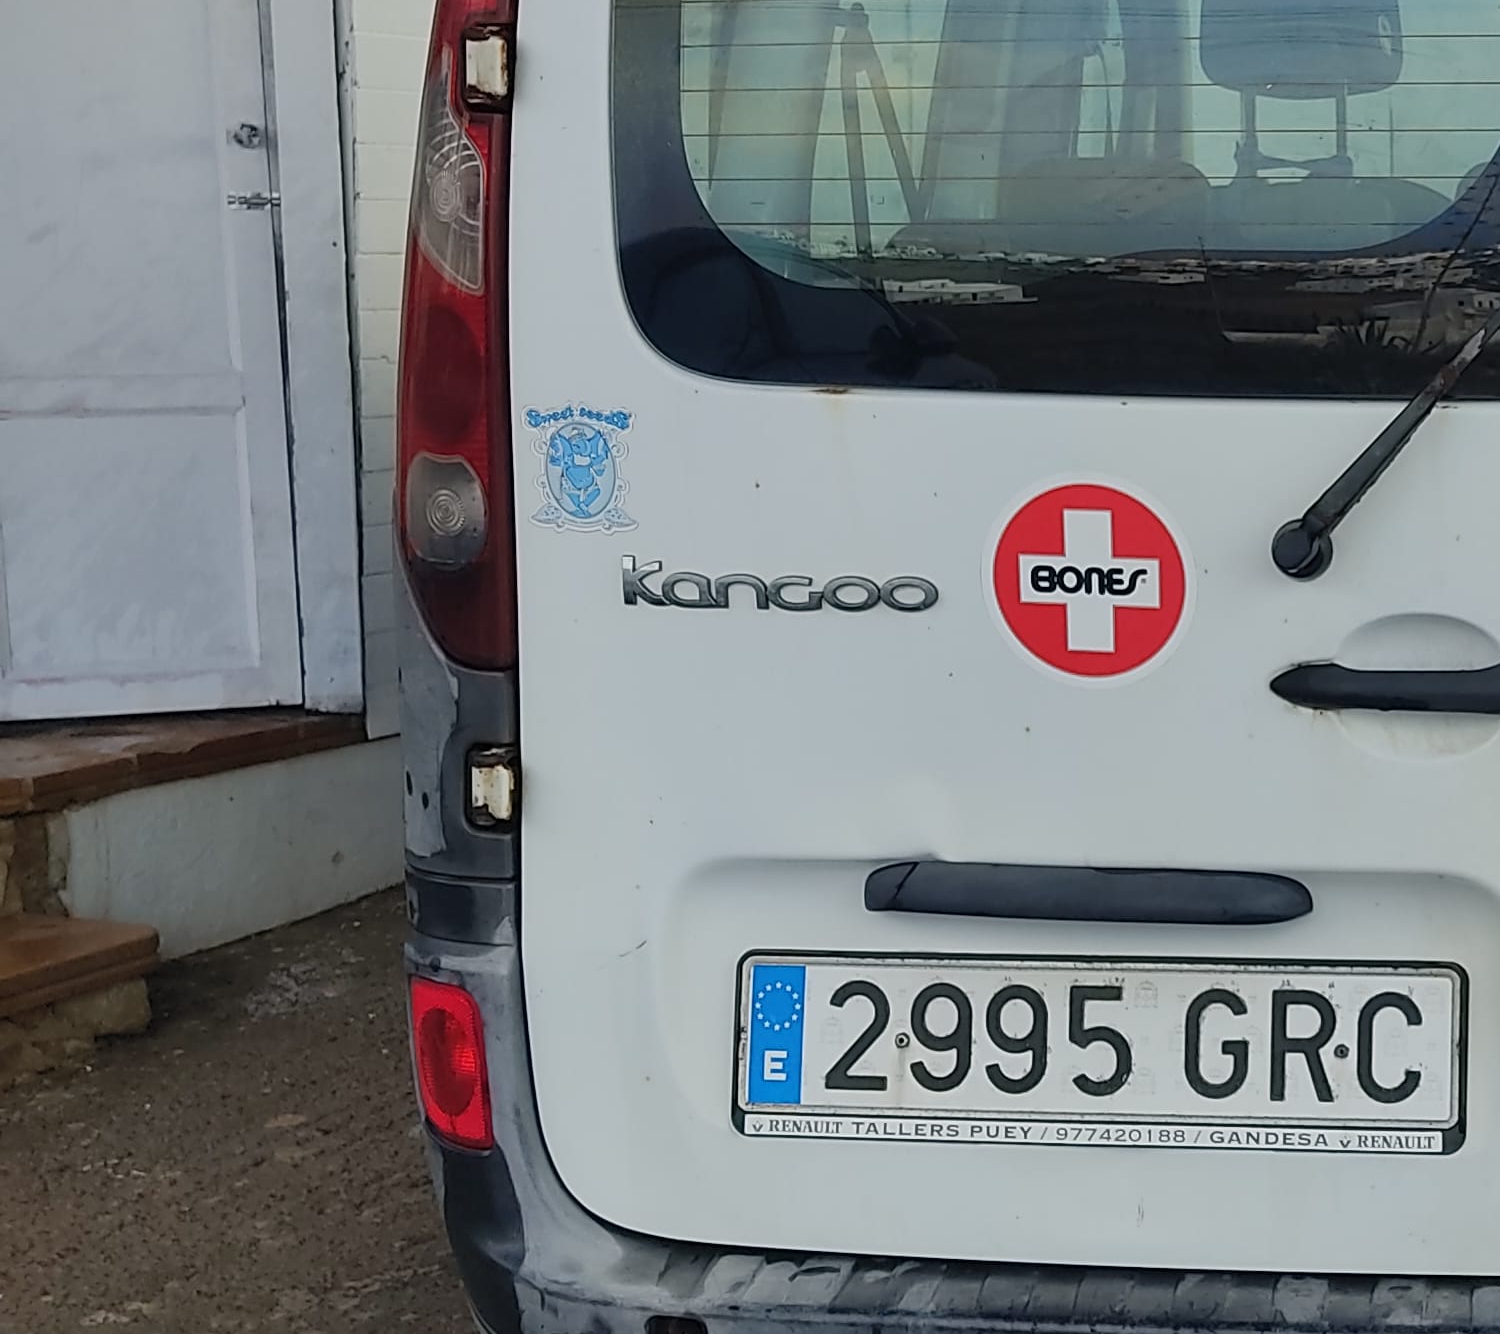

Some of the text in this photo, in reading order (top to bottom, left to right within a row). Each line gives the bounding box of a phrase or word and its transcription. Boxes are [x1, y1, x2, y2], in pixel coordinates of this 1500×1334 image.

[825, 980, 1424, 1104] 2995 GRC
[763, 1051, 787, 1080] E
[769, 1120, 843, 1135] RENAULT
[852, 1121, 960, 1137] TALLERS
[970, 1124, 1032, 1140] PUEY
[1056, 1127, 1186, 1144] 977420188
[1209, 1130, 1329, 1147] GANDESA
[1357, 1135, 1436, 1150] RENAULT
